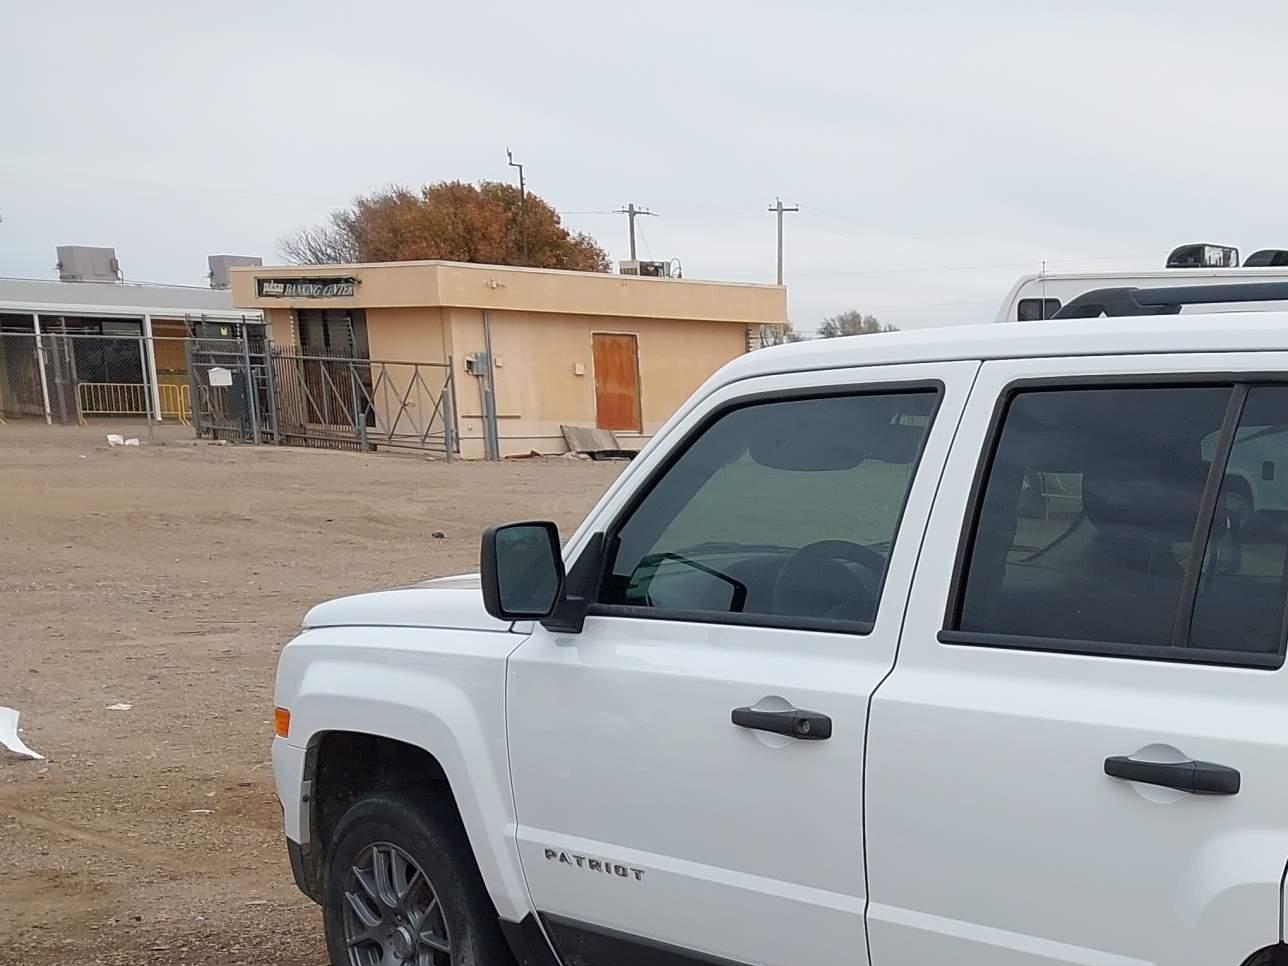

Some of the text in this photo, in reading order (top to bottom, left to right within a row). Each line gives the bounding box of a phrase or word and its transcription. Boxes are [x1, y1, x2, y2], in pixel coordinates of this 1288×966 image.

[284, 284, 321, 296] BANKING
[323, 283, 353, 296] CENTER
[545, 848, 645, 881] PATRIOT
